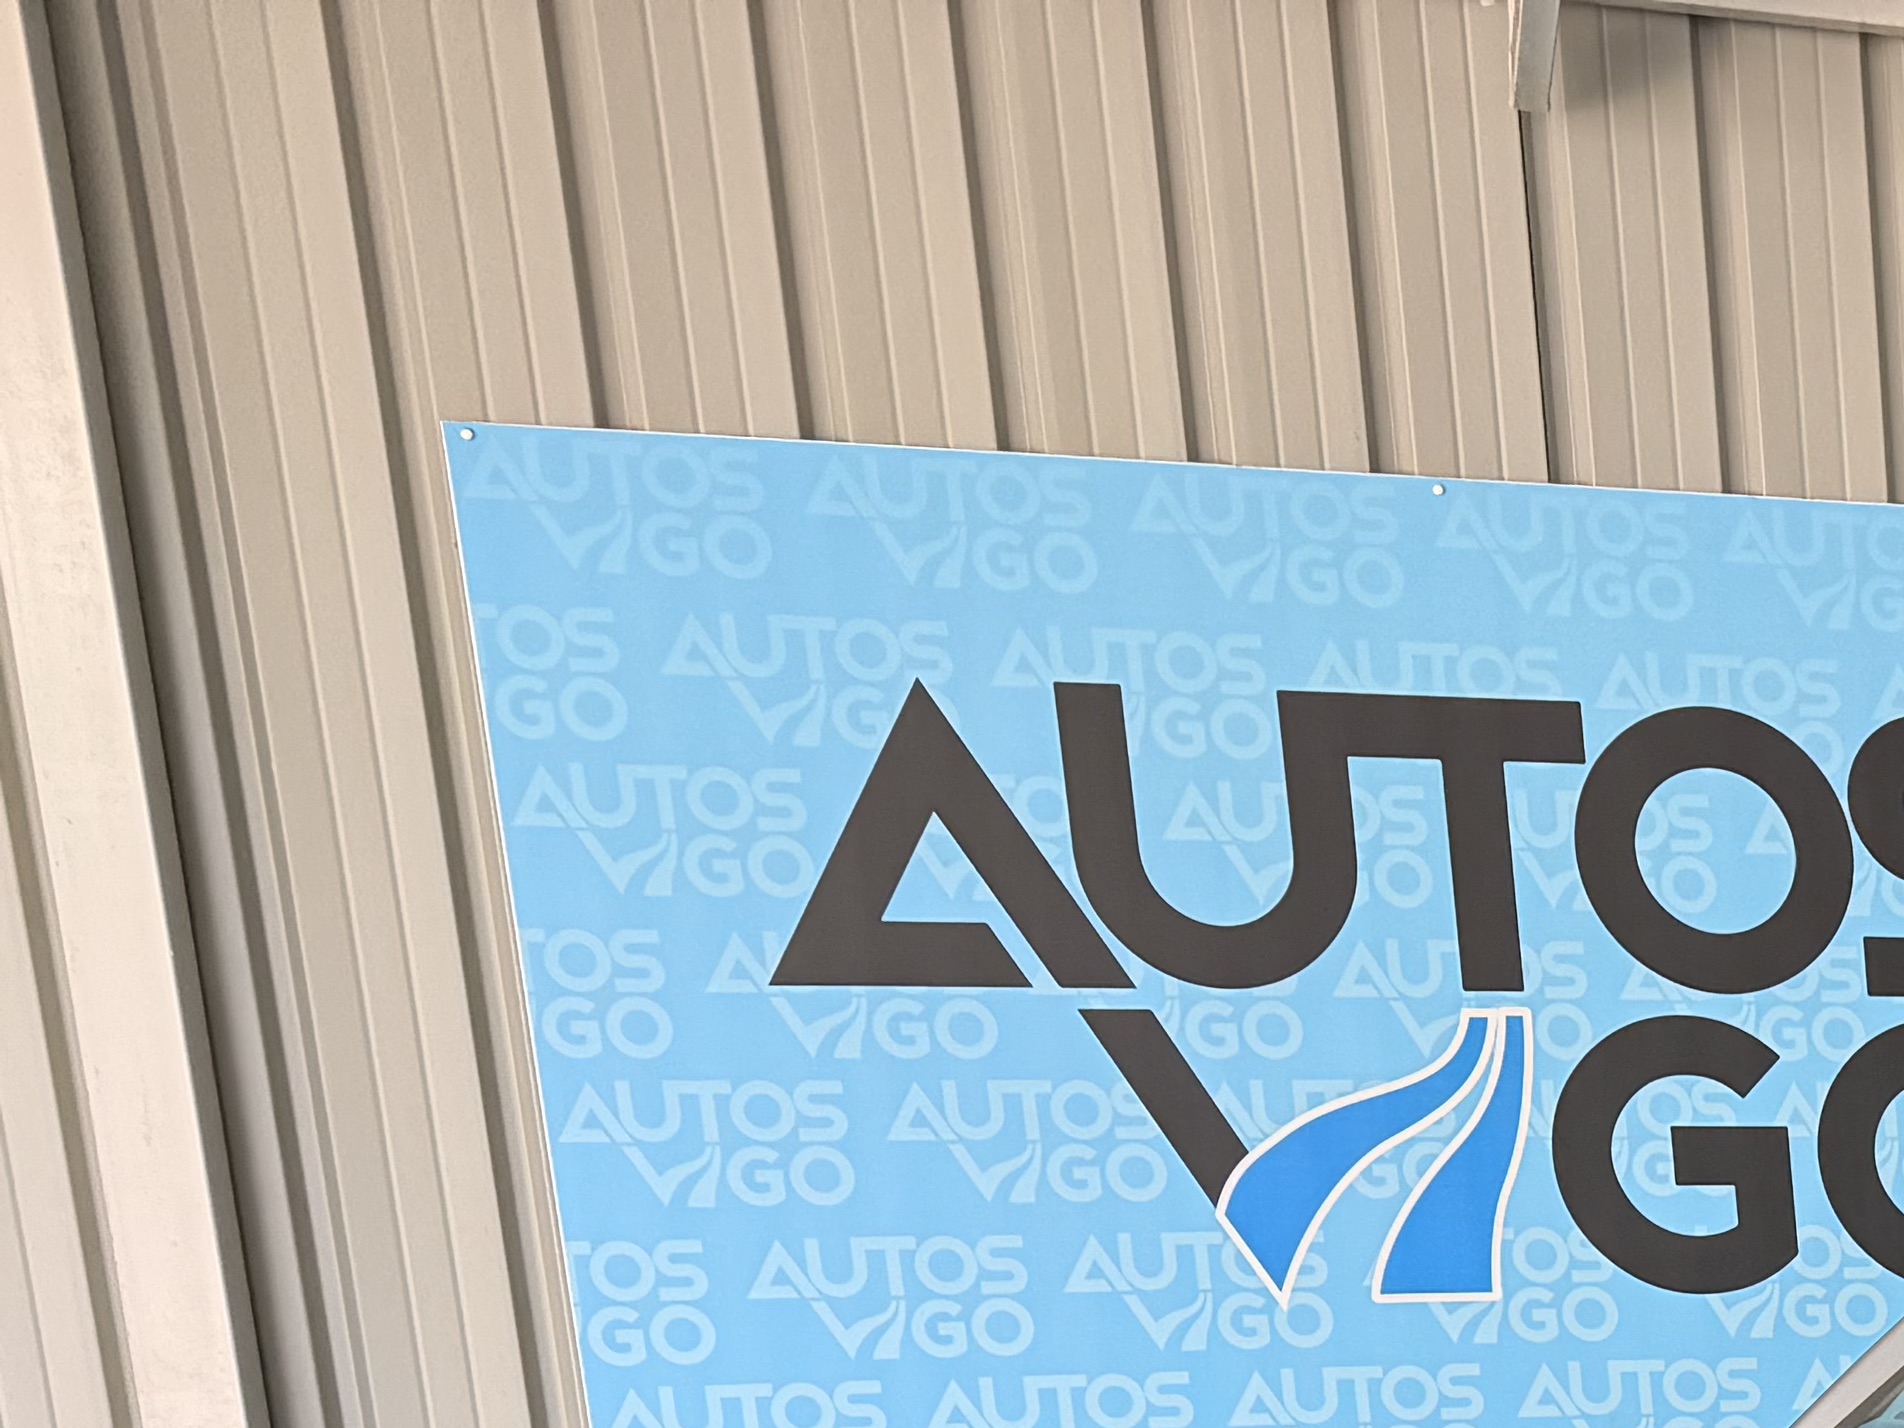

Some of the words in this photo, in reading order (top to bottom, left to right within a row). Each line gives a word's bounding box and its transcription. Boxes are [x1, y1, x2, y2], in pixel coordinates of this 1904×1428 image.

[463, 438, 766, 512] AUTOS
[804, 455, 1092, 528] AUTOS
[1130, 472, 1400, 545] AUTOS
[1436, 498, 1690, 559] AUTOS
[660, 611, 953, 687] AUTOS
[513, 763, 808, 832] AUTOS
[559, 1079, 848, 1144] AUTOS
[747, 1234, 1028, 1299] AUTOS
[1226, 1363, 1486, 1428] AUTOS
[1517, 1357, 1761, 1418] AUTOS
